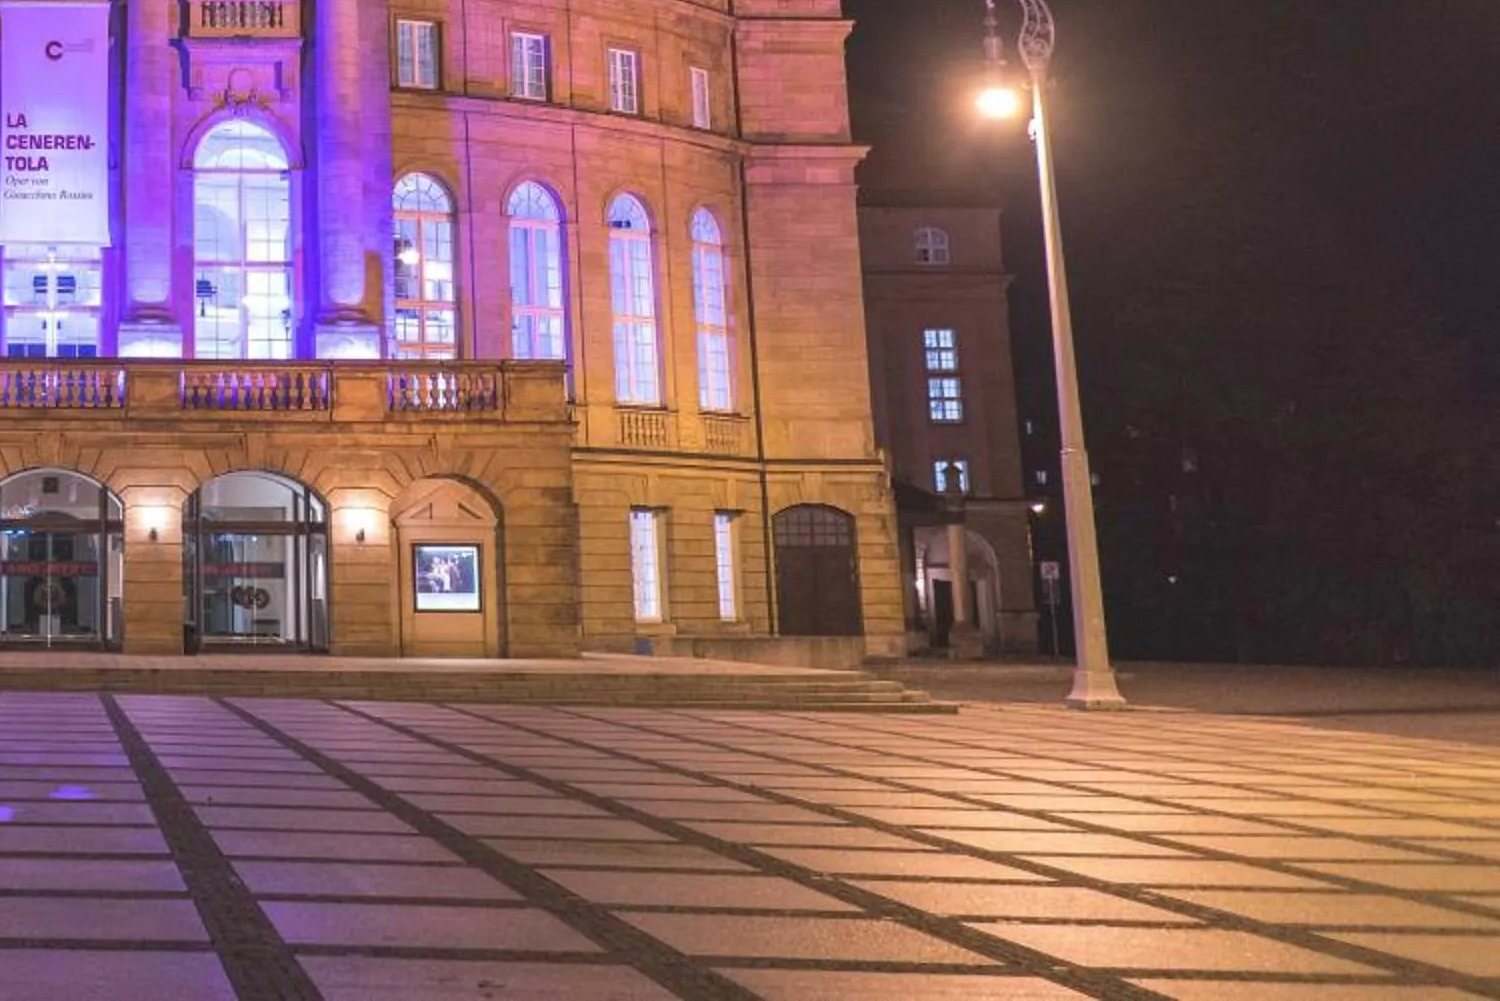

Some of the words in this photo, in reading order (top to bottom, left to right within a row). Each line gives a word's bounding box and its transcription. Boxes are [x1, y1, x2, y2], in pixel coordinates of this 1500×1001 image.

[45, 40, 63, 61] C
[7, 113, 28, 128] LA
[6, 134, 96, 150] CENEREN-
[5, 156, 49, 171] TOLA
